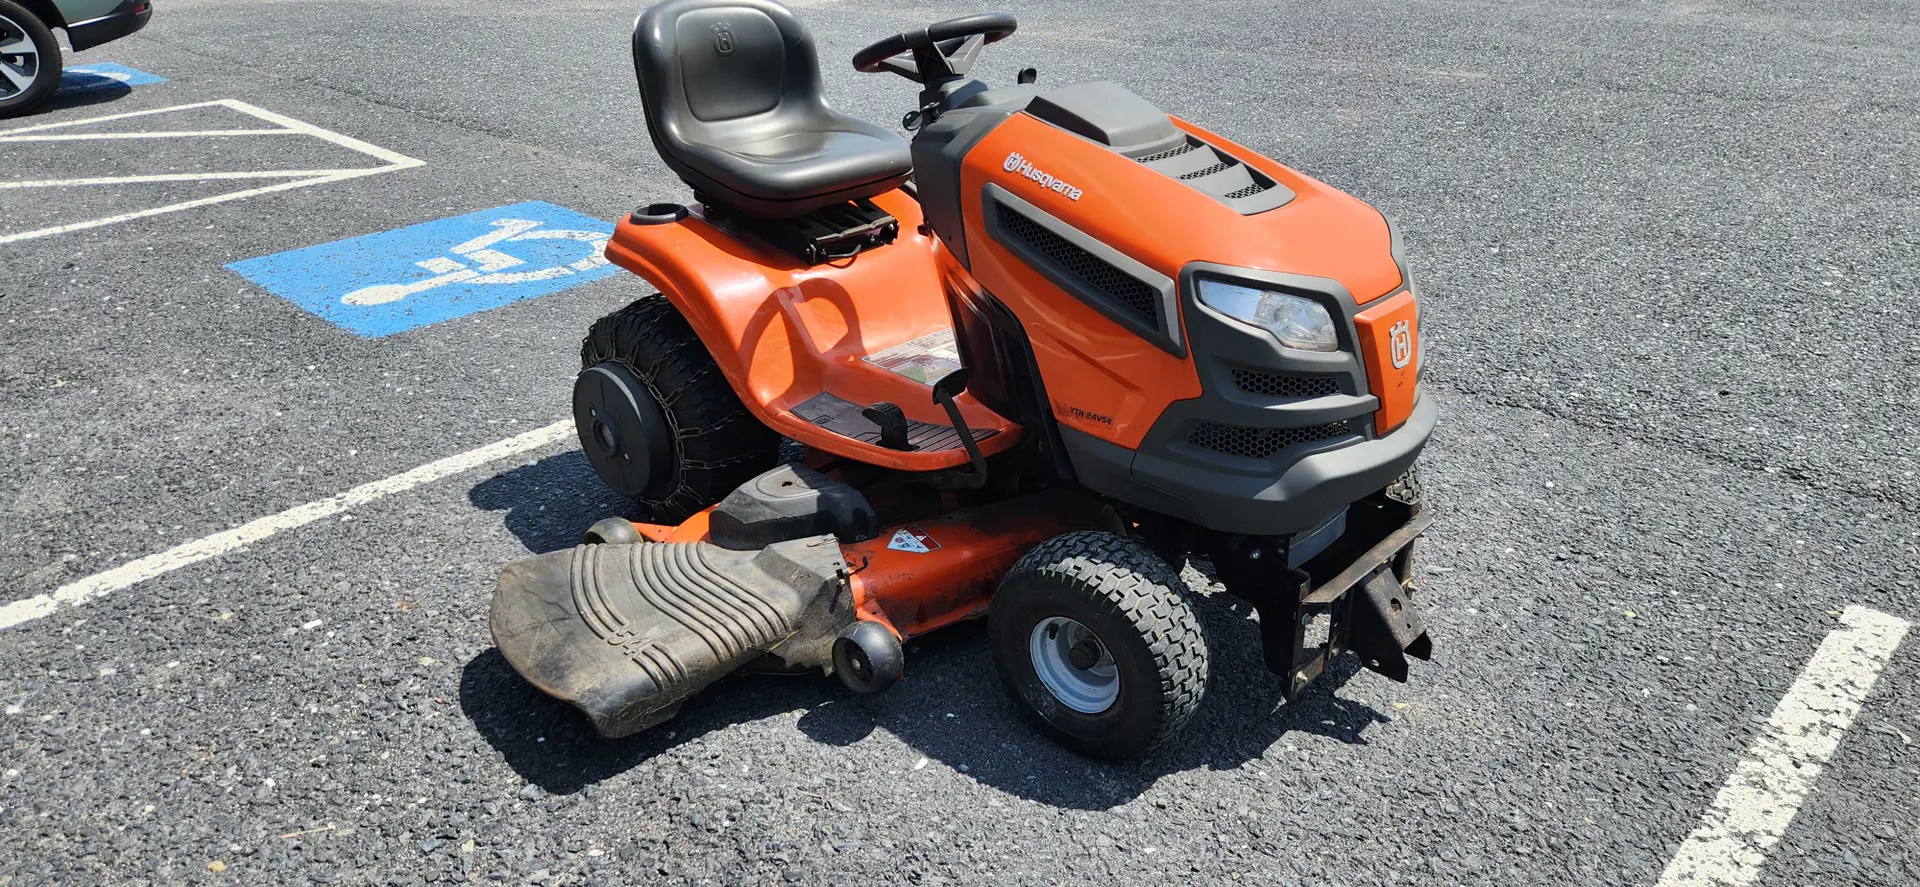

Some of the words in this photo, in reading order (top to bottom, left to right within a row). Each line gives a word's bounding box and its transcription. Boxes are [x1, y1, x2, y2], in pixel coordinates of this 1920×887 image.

[1016, 159, 1082, 201] Husqvarna
[1070, 406, 1085, 417] YTH
[1086, 411, 1113, 425] 24V54
